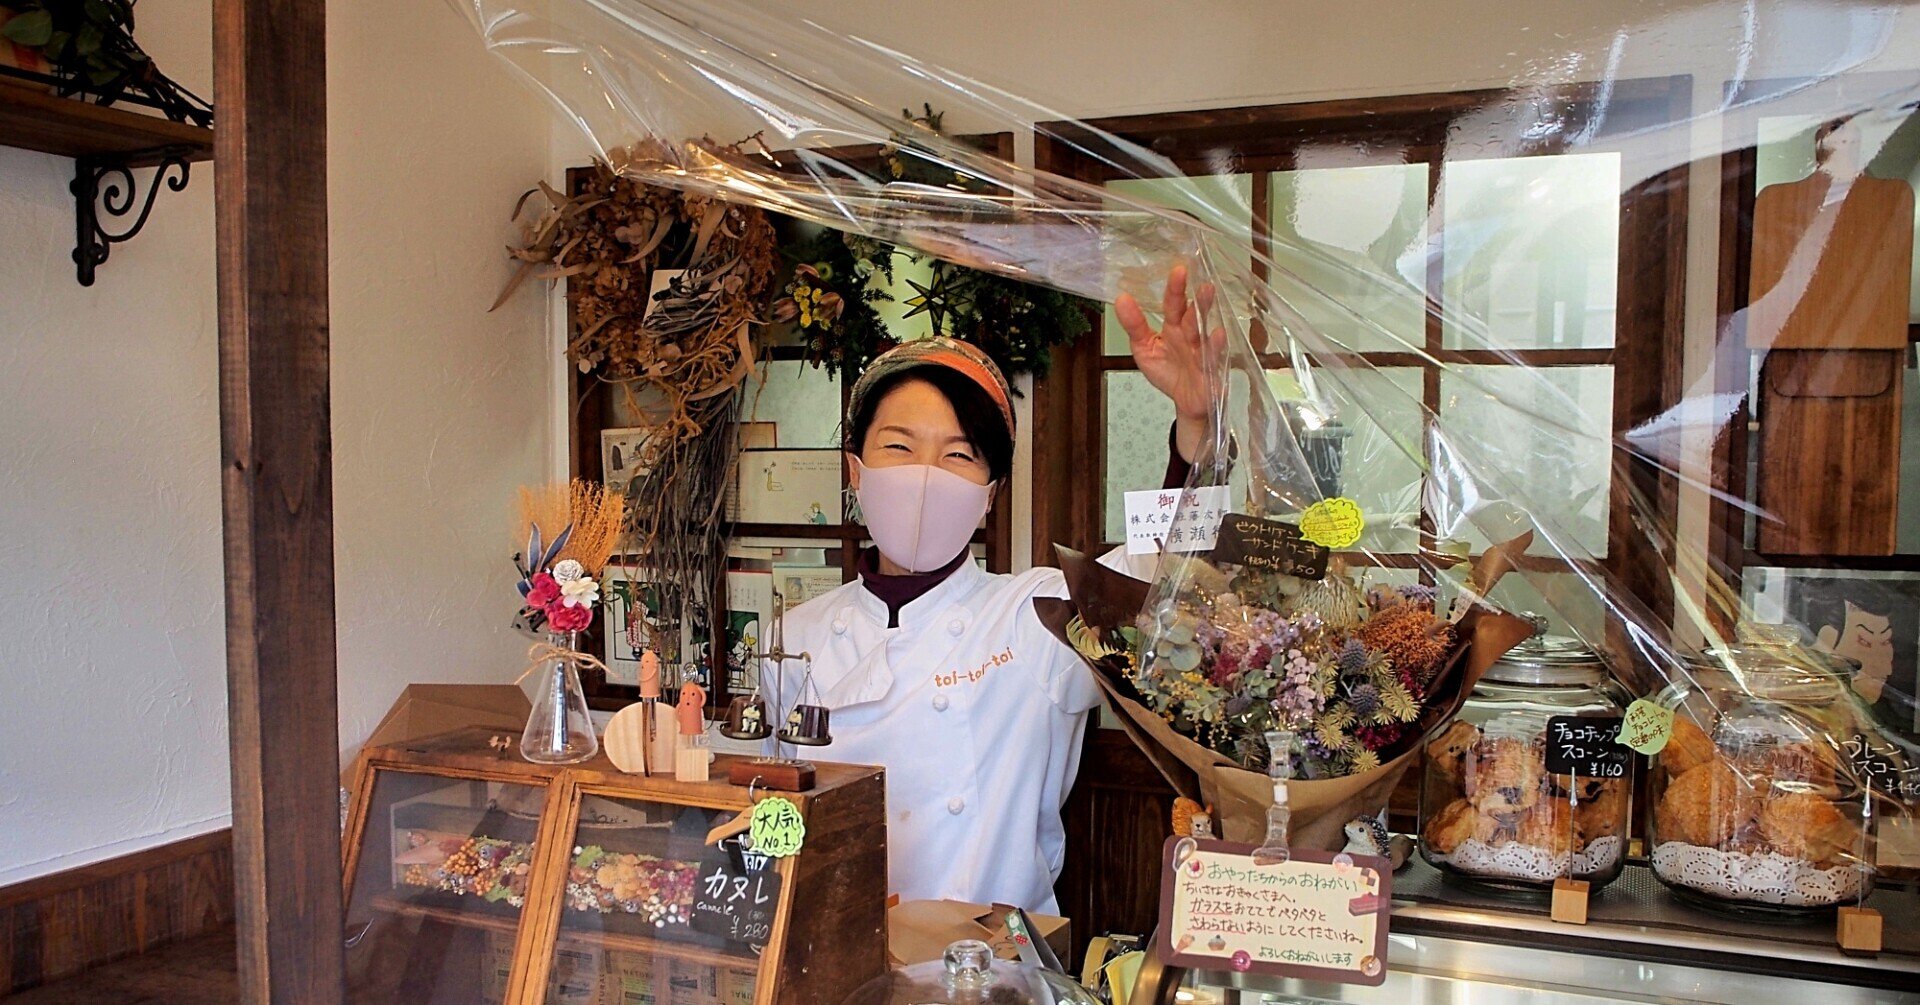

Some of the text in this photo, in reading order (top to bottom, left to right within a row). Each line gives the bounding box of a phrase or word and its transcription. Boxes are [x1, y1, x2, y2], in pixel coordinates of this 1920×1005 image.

[934, 646, 1014, 688] toi-toi-toi
[1554, 721, 1621, 744] チョコチップ
[1561, 744, 1610, 761] スコーン
[1841, 734, 1901, 760] プレーン
[1590, 763, 1623, 777] ¥160
[704, 867, 769, 904] カヌレ
[1258, 946, 1353, 966] よろしくおねがいします
